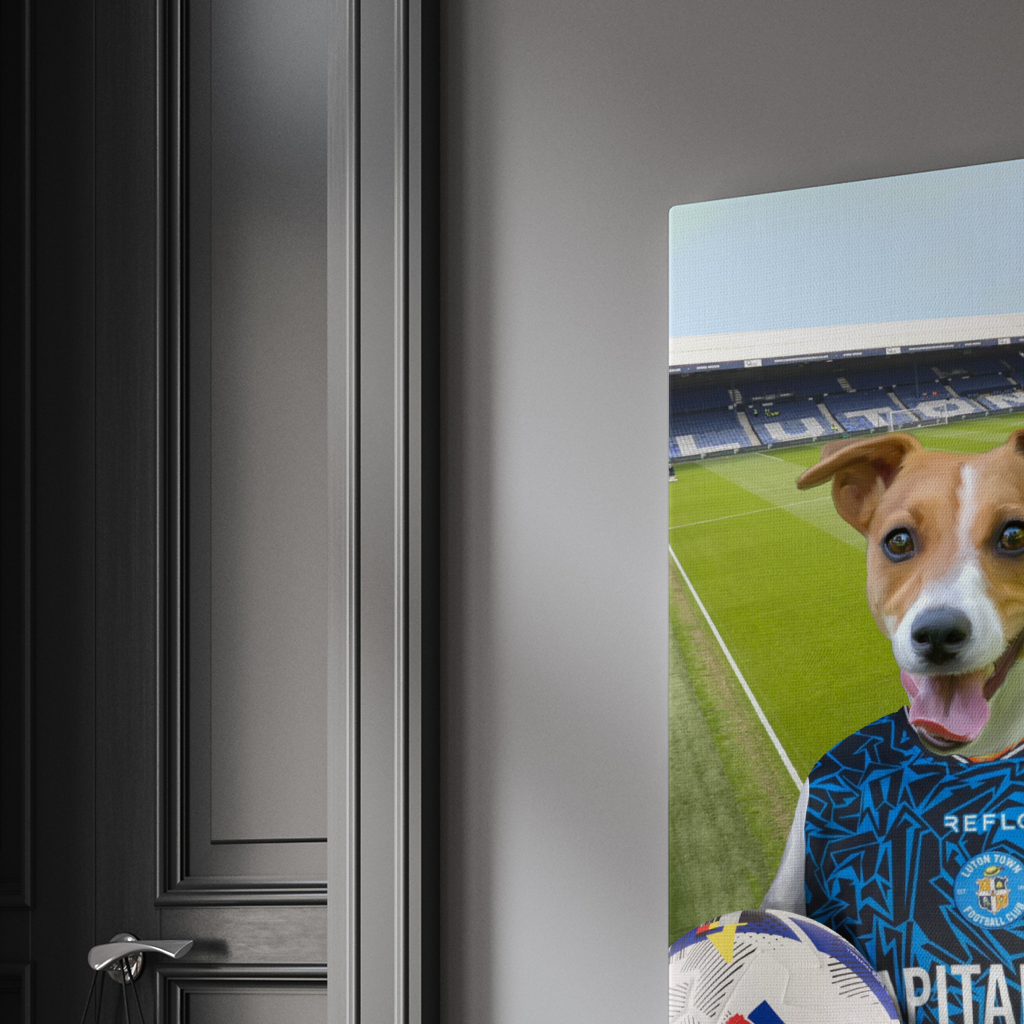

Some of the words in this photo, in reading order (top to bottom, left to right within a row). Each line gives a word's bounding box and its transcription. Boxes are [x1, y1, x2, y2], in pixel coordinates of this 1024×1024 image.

[961, 854, 991, 878] LUTON
[993, 854, 1023, 874] TOWN
[963, 905, 1006, 927] FOOTBALL
